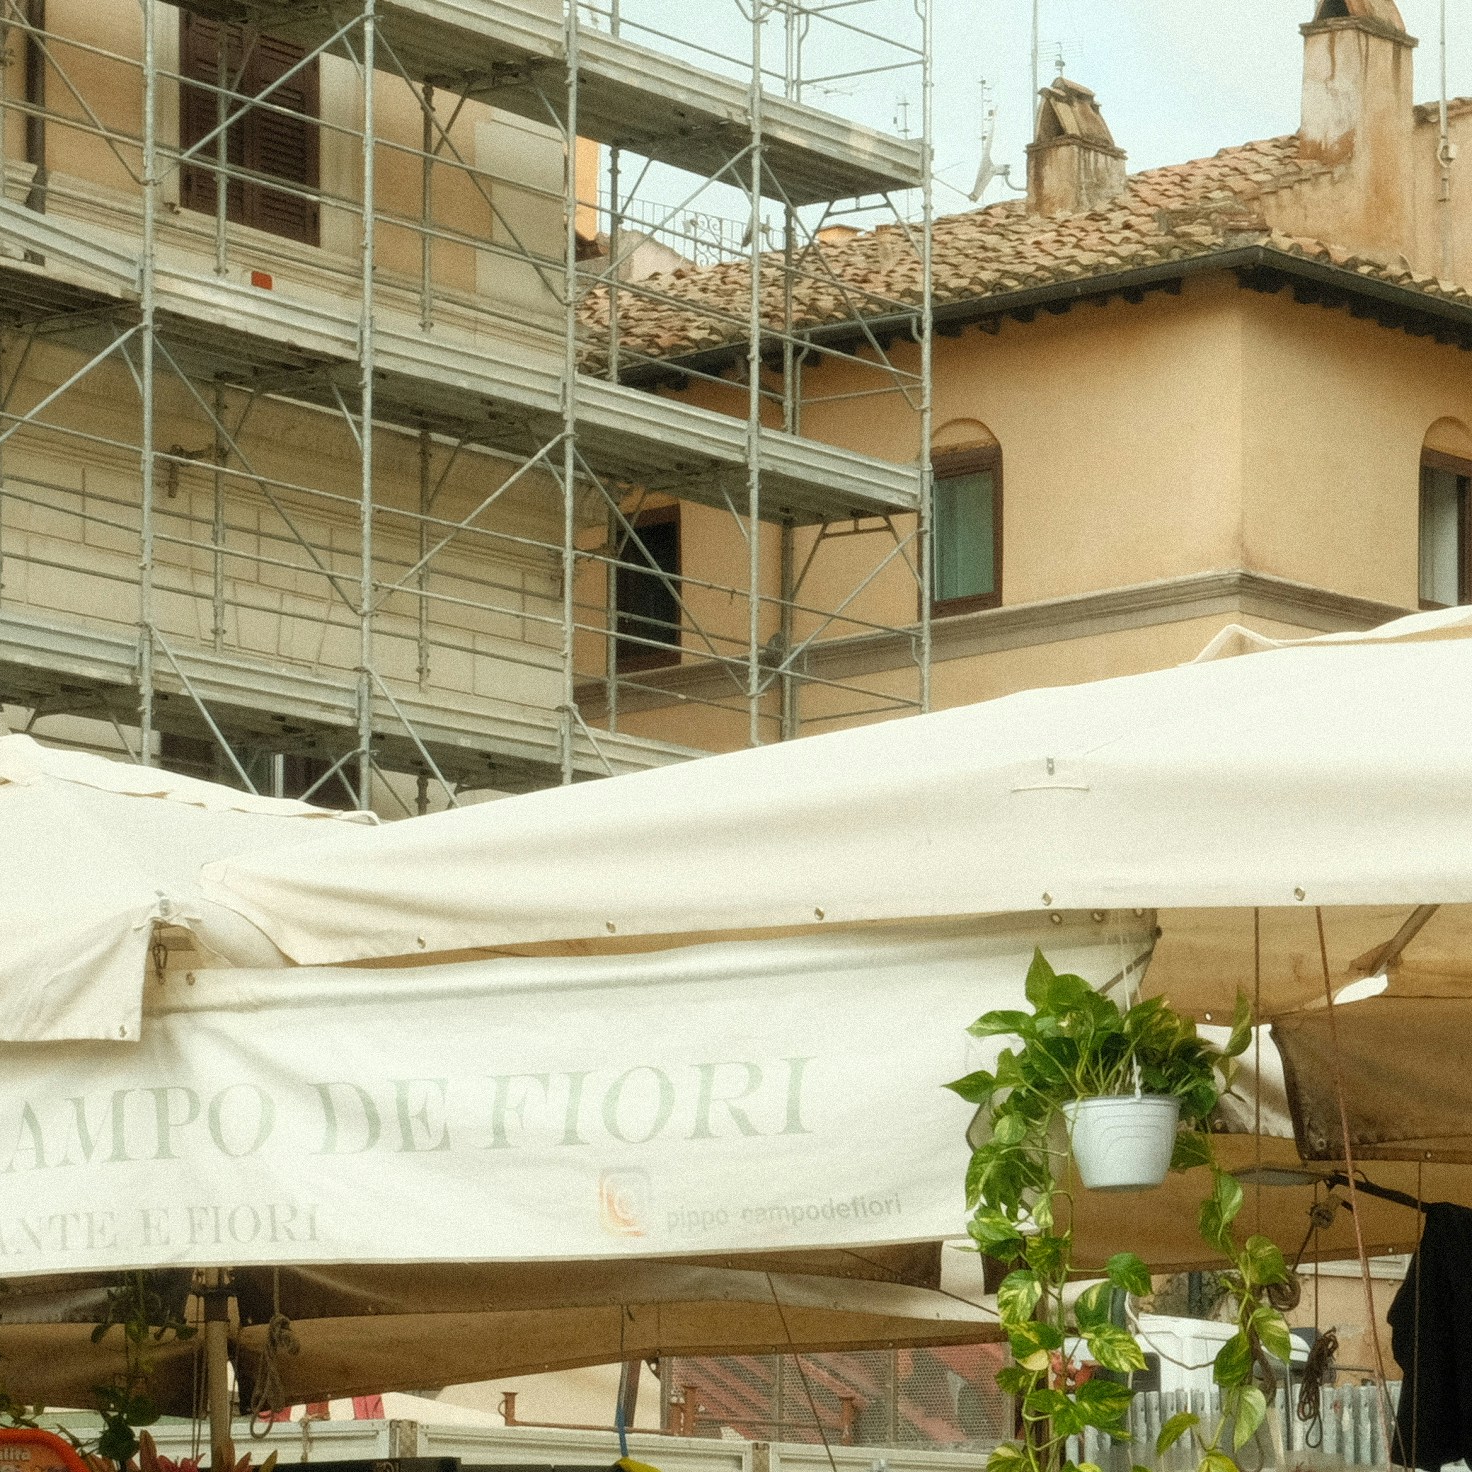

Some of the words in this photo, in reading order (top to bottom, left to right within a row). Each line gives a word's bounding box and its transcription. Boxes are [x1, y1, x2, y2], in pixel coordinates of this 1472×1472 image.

[306, 1076, 452, 1157] DE
[482, 1056, 818, 1151] FIORI
[140, 1207, 173, 1247] E
[186, 1202, 322, 1246] FIORI
